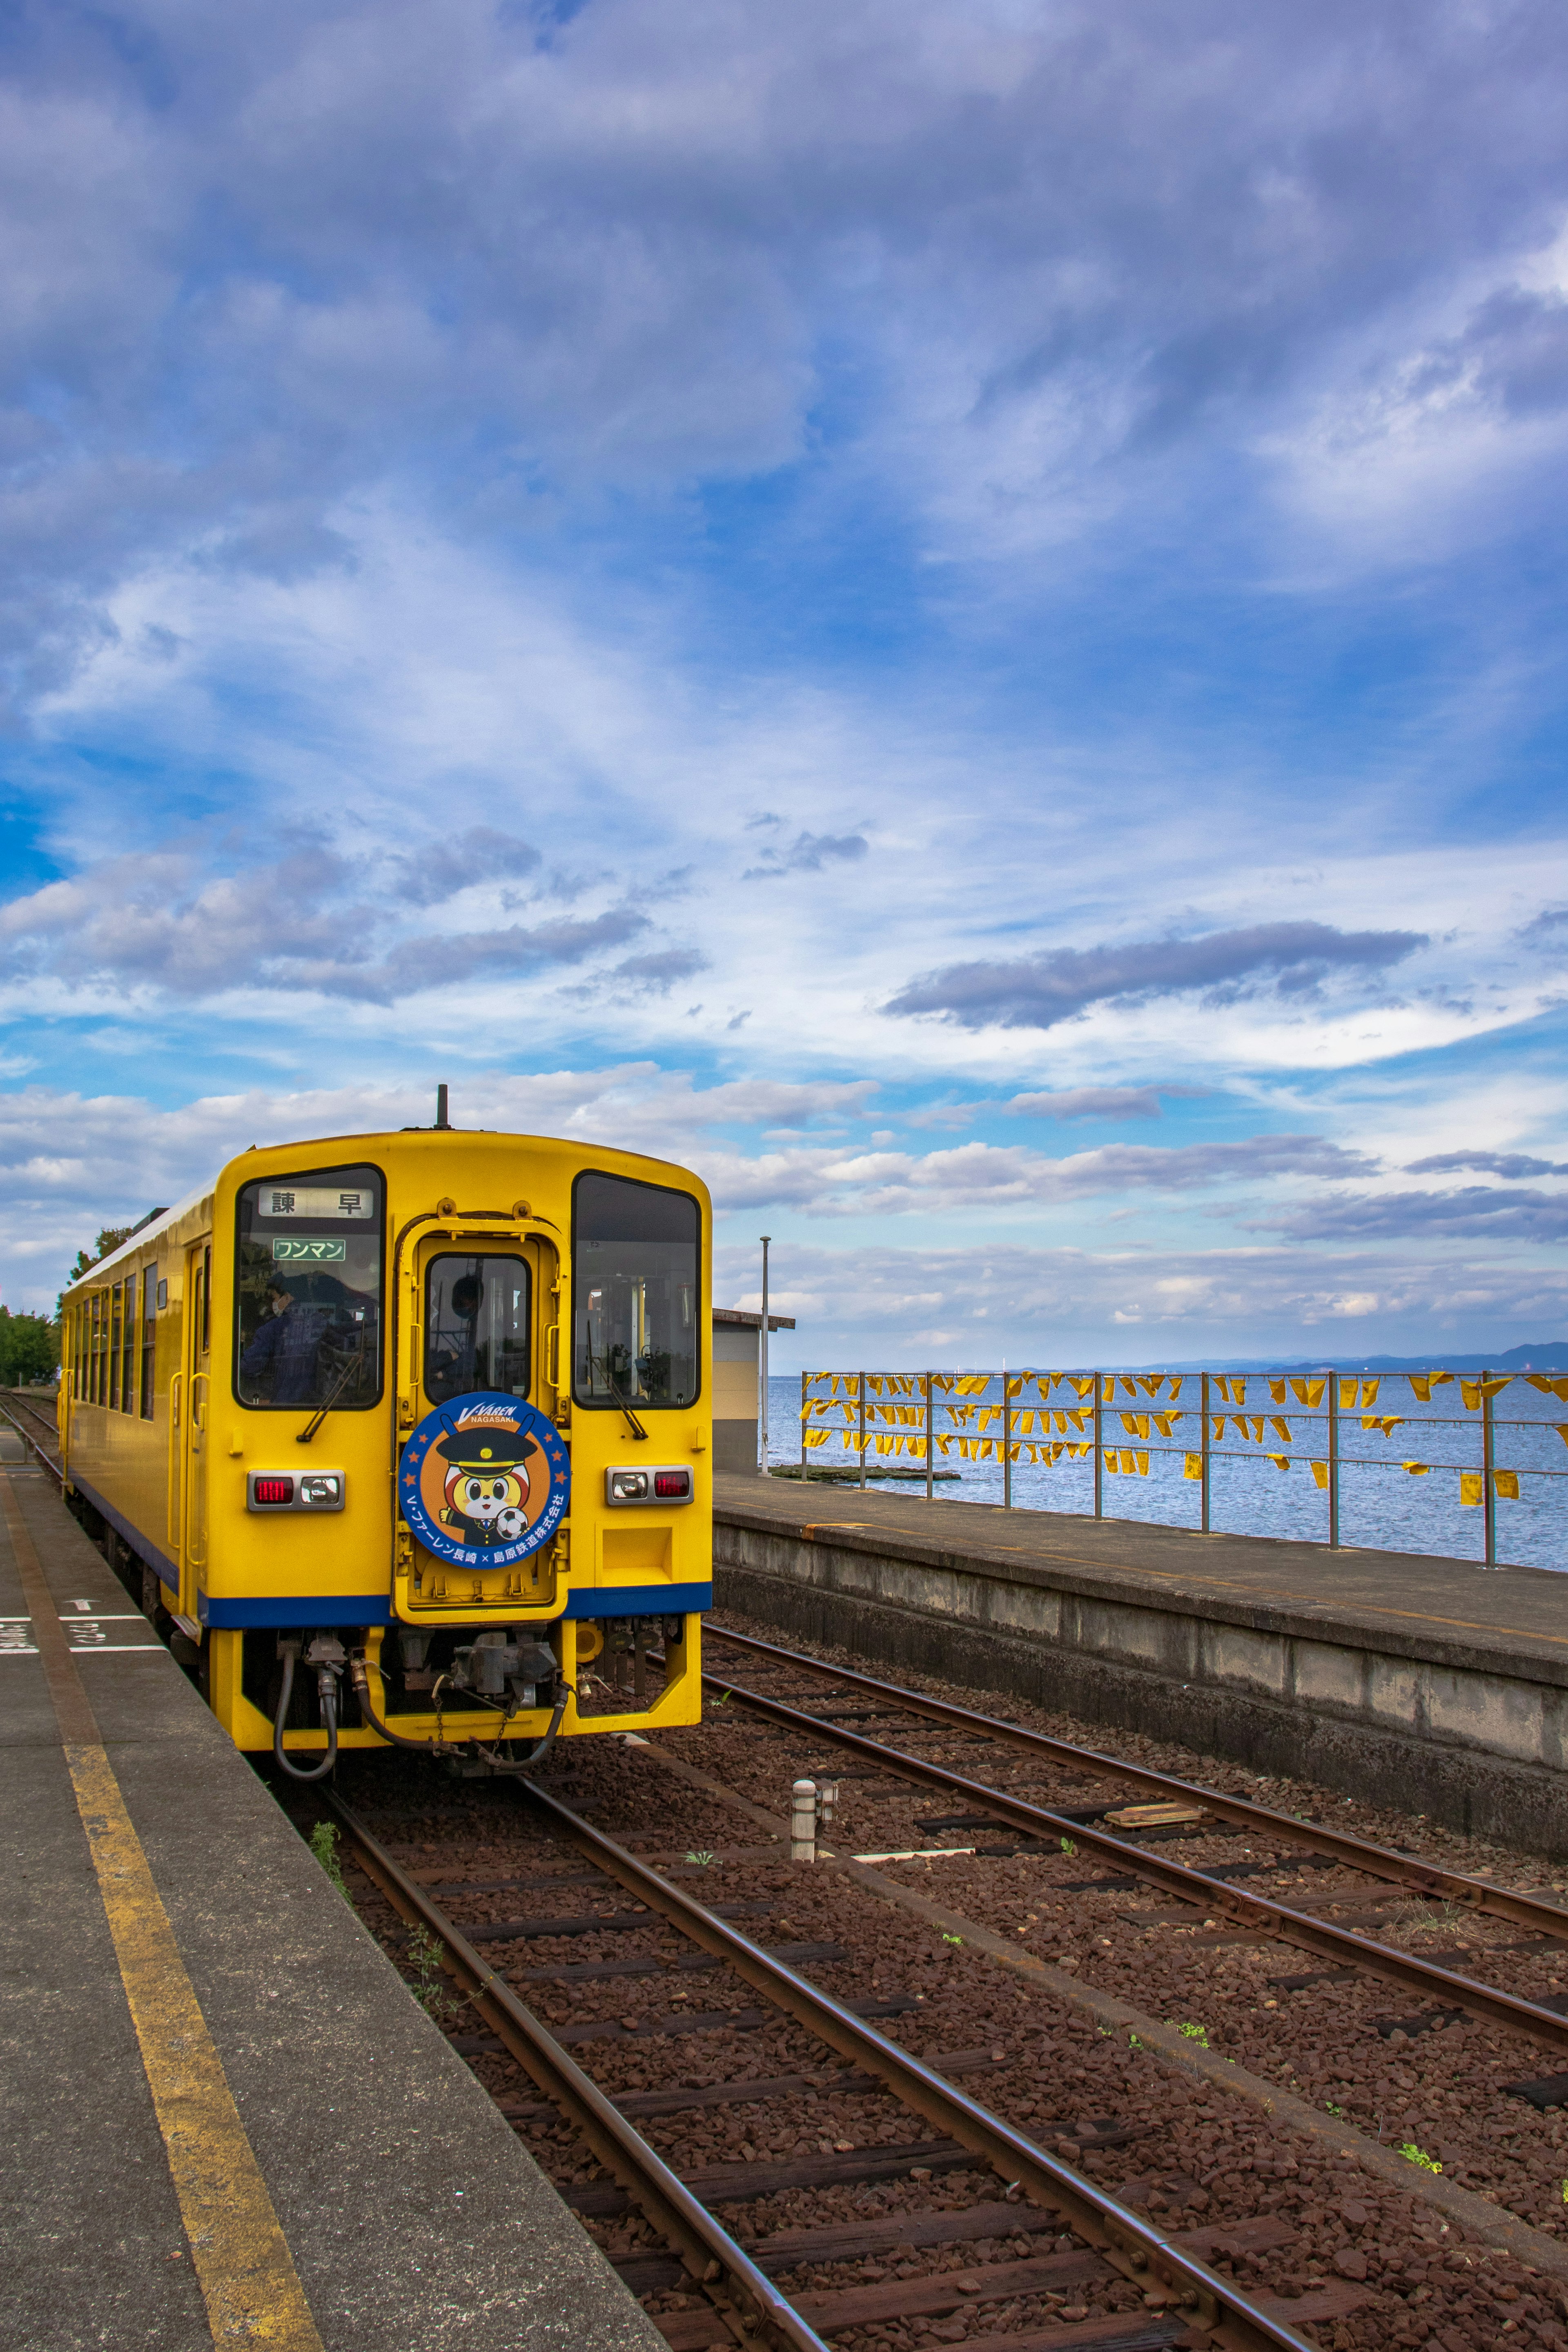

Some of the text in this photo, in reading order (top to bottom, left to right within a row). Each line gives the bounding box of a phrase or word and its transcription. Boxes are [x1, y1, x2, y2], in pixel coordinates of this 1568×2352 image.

[272, 1192, 361, 1214] 諫早
[276, 1242, 342, 1258] ワンマン
[494, 1494, 564, 1563] 島原鉄道株式会社
